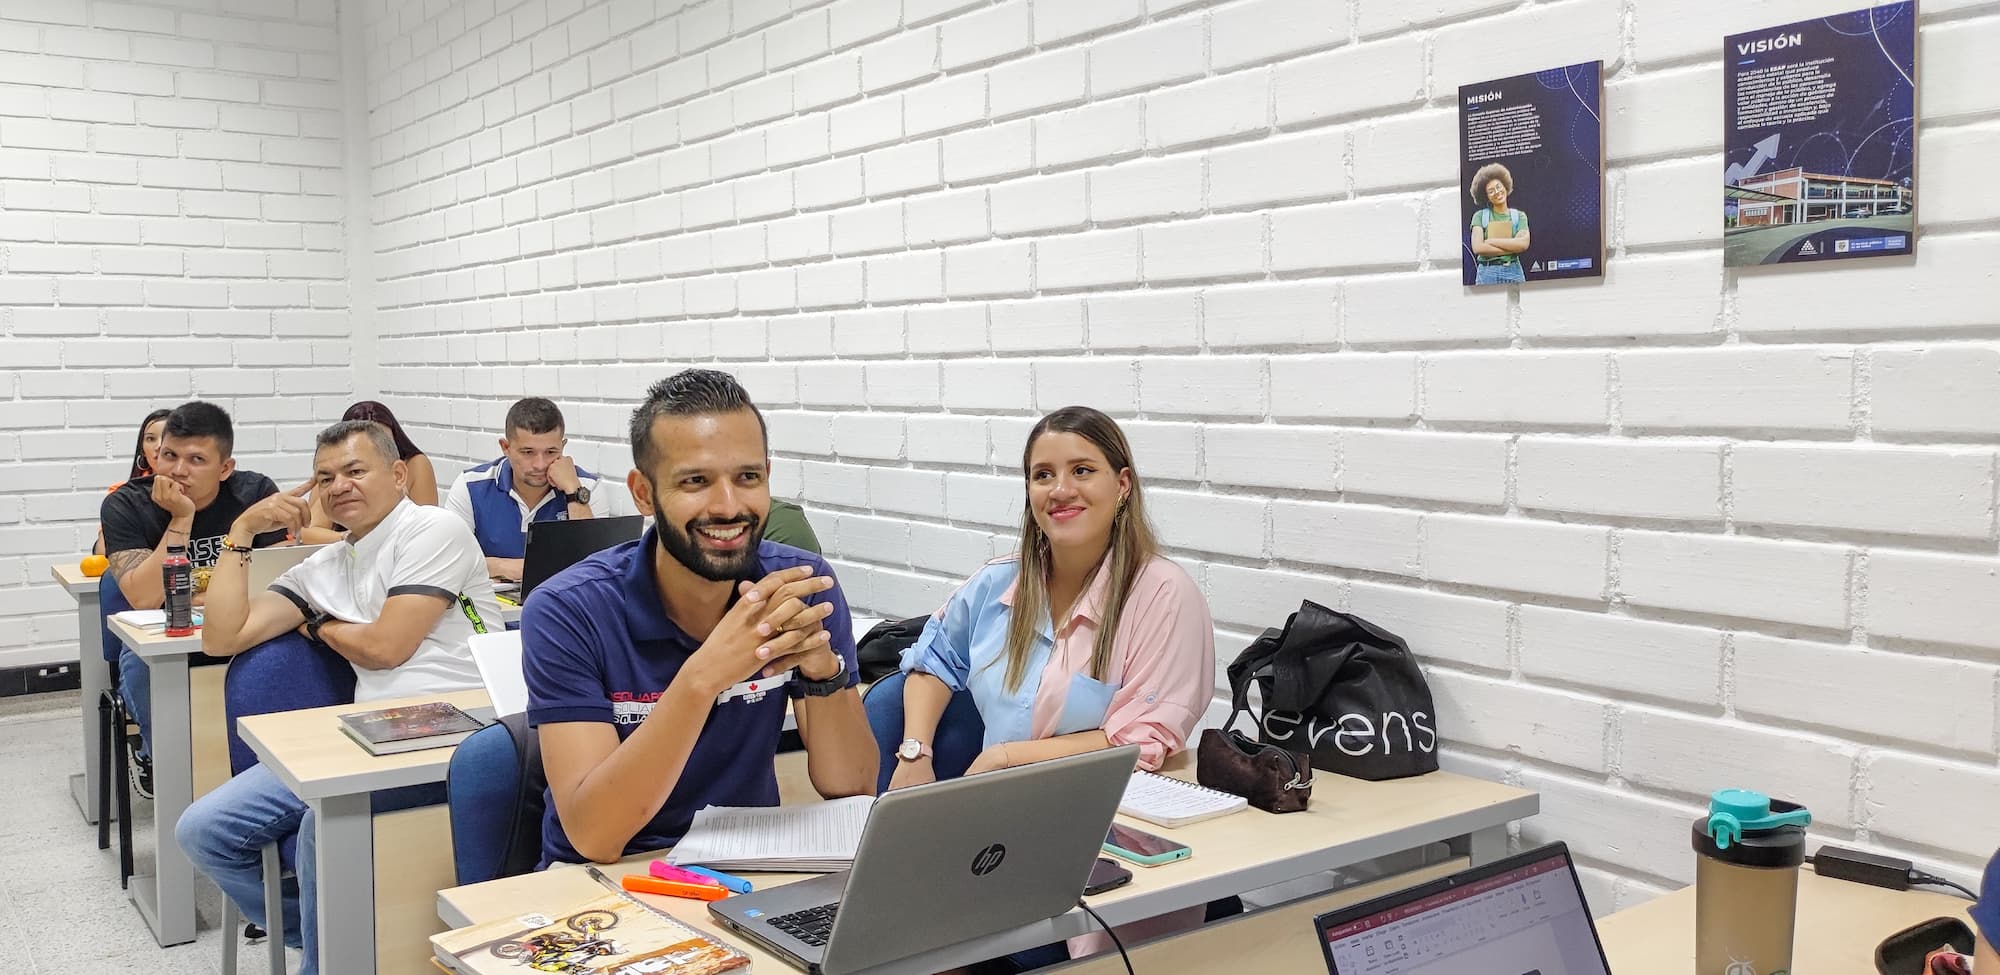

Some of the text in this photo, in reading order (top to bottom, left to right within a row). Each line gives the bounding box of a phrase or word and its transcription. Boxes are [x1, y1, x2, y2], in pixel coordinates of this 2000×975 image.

[1737, 32, 1802, 56] VISIÓN
[1467, 90, 1502, 105] MISIÓN
[611, 691, 664, 702] SQUAR
[1263, 709, 1435, 757] evens
[974, 845, 1004, 876] hp
